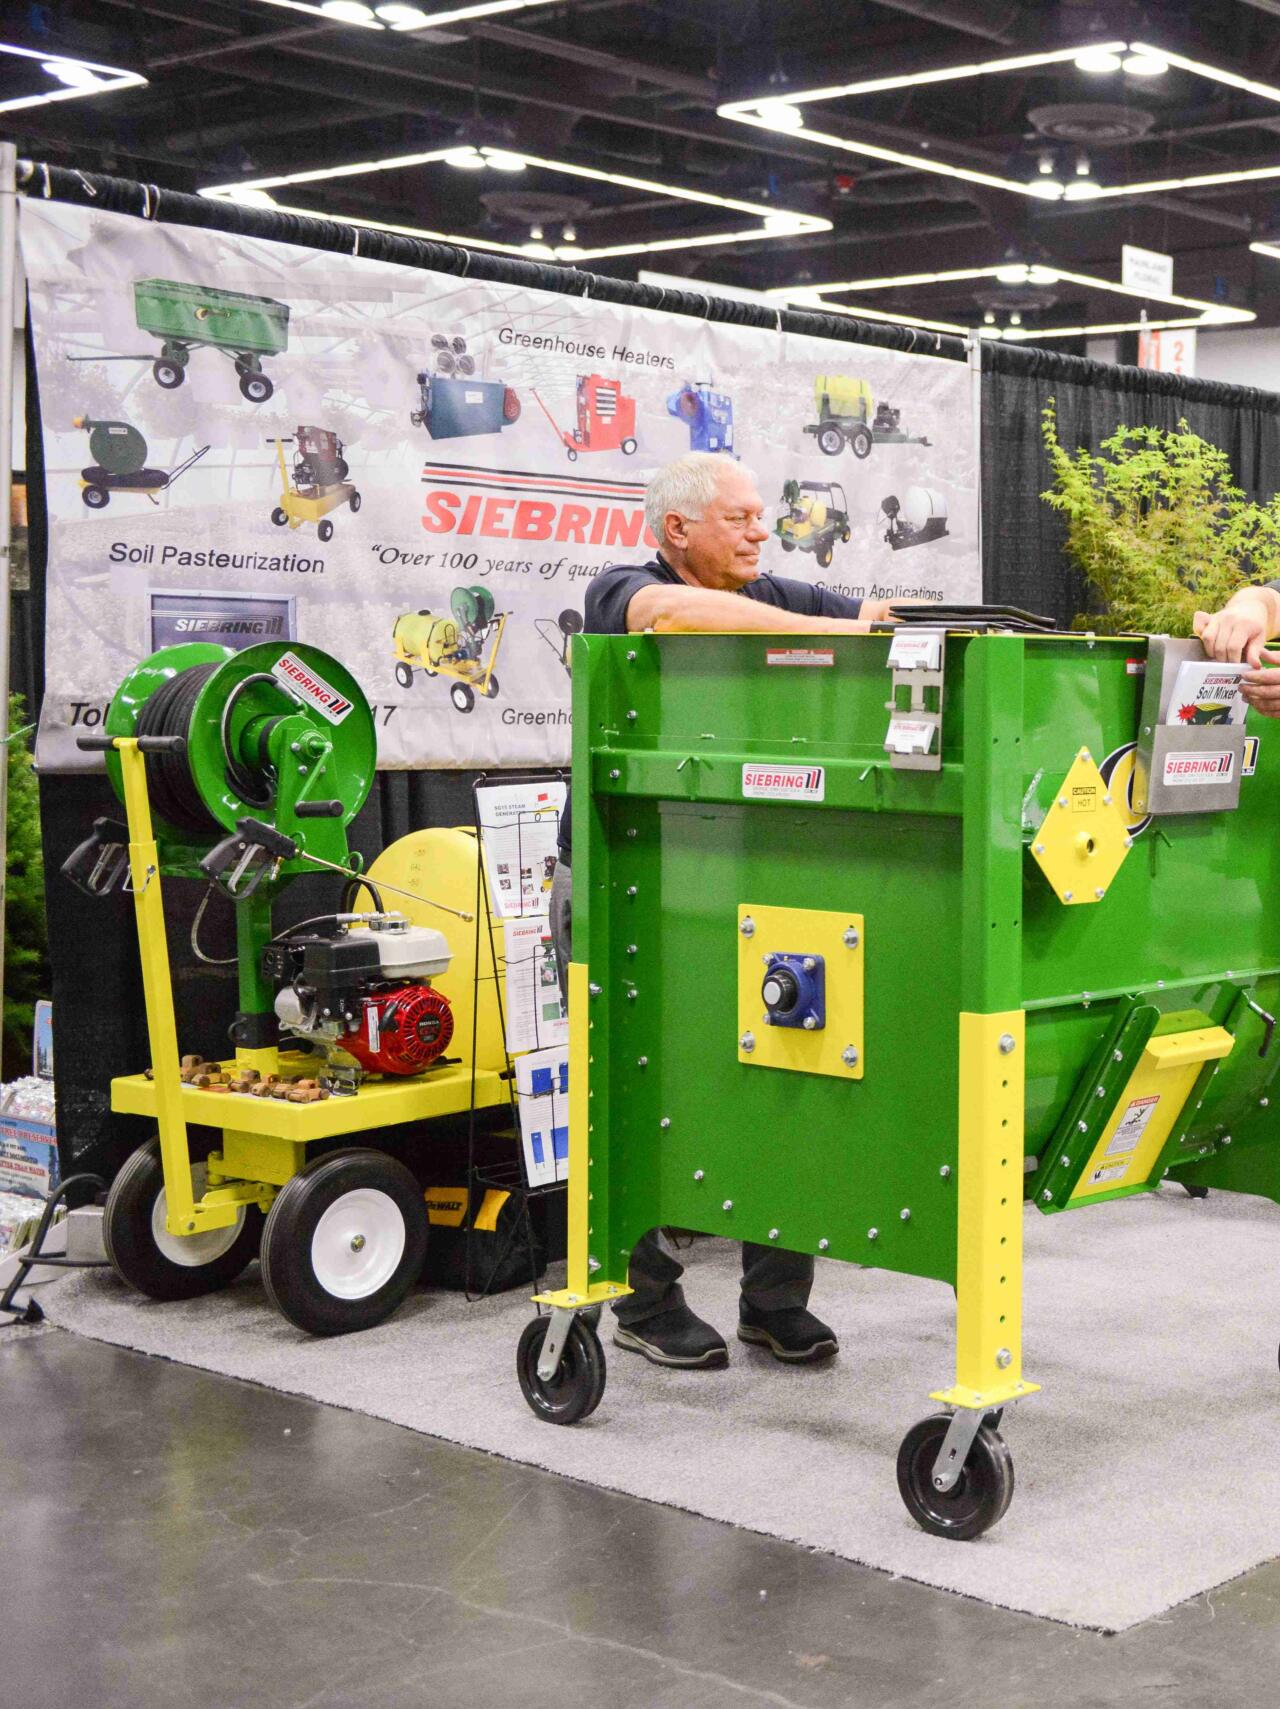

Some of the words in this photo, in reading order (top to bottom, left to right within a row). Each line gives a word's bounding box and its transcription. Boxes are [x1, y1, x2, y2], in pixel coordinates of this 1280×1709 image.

[498, 327, 606, 359] Greenhouse
[612, 344, 675, 370] Heaters
[109, 542, 155, 564] Soil
[161, 545, 325, 574] Pasteurization
[439, 551, 478, 570] 100
[480, 556, 531, 577] years
[539, 556, 568, 580] of
[869, 583, 944, 602] Applications
[174, 618, 265, 635] SIEBRING
[278, 657, 331, 704] SIEBRING
[1196, 686, 1215, 700] Soil
[1213, 686, 1238, 700] Mixer
[1166, 761, 1218, 774] SIEBRING
[744, 773, 804, 789] SIEBRING
